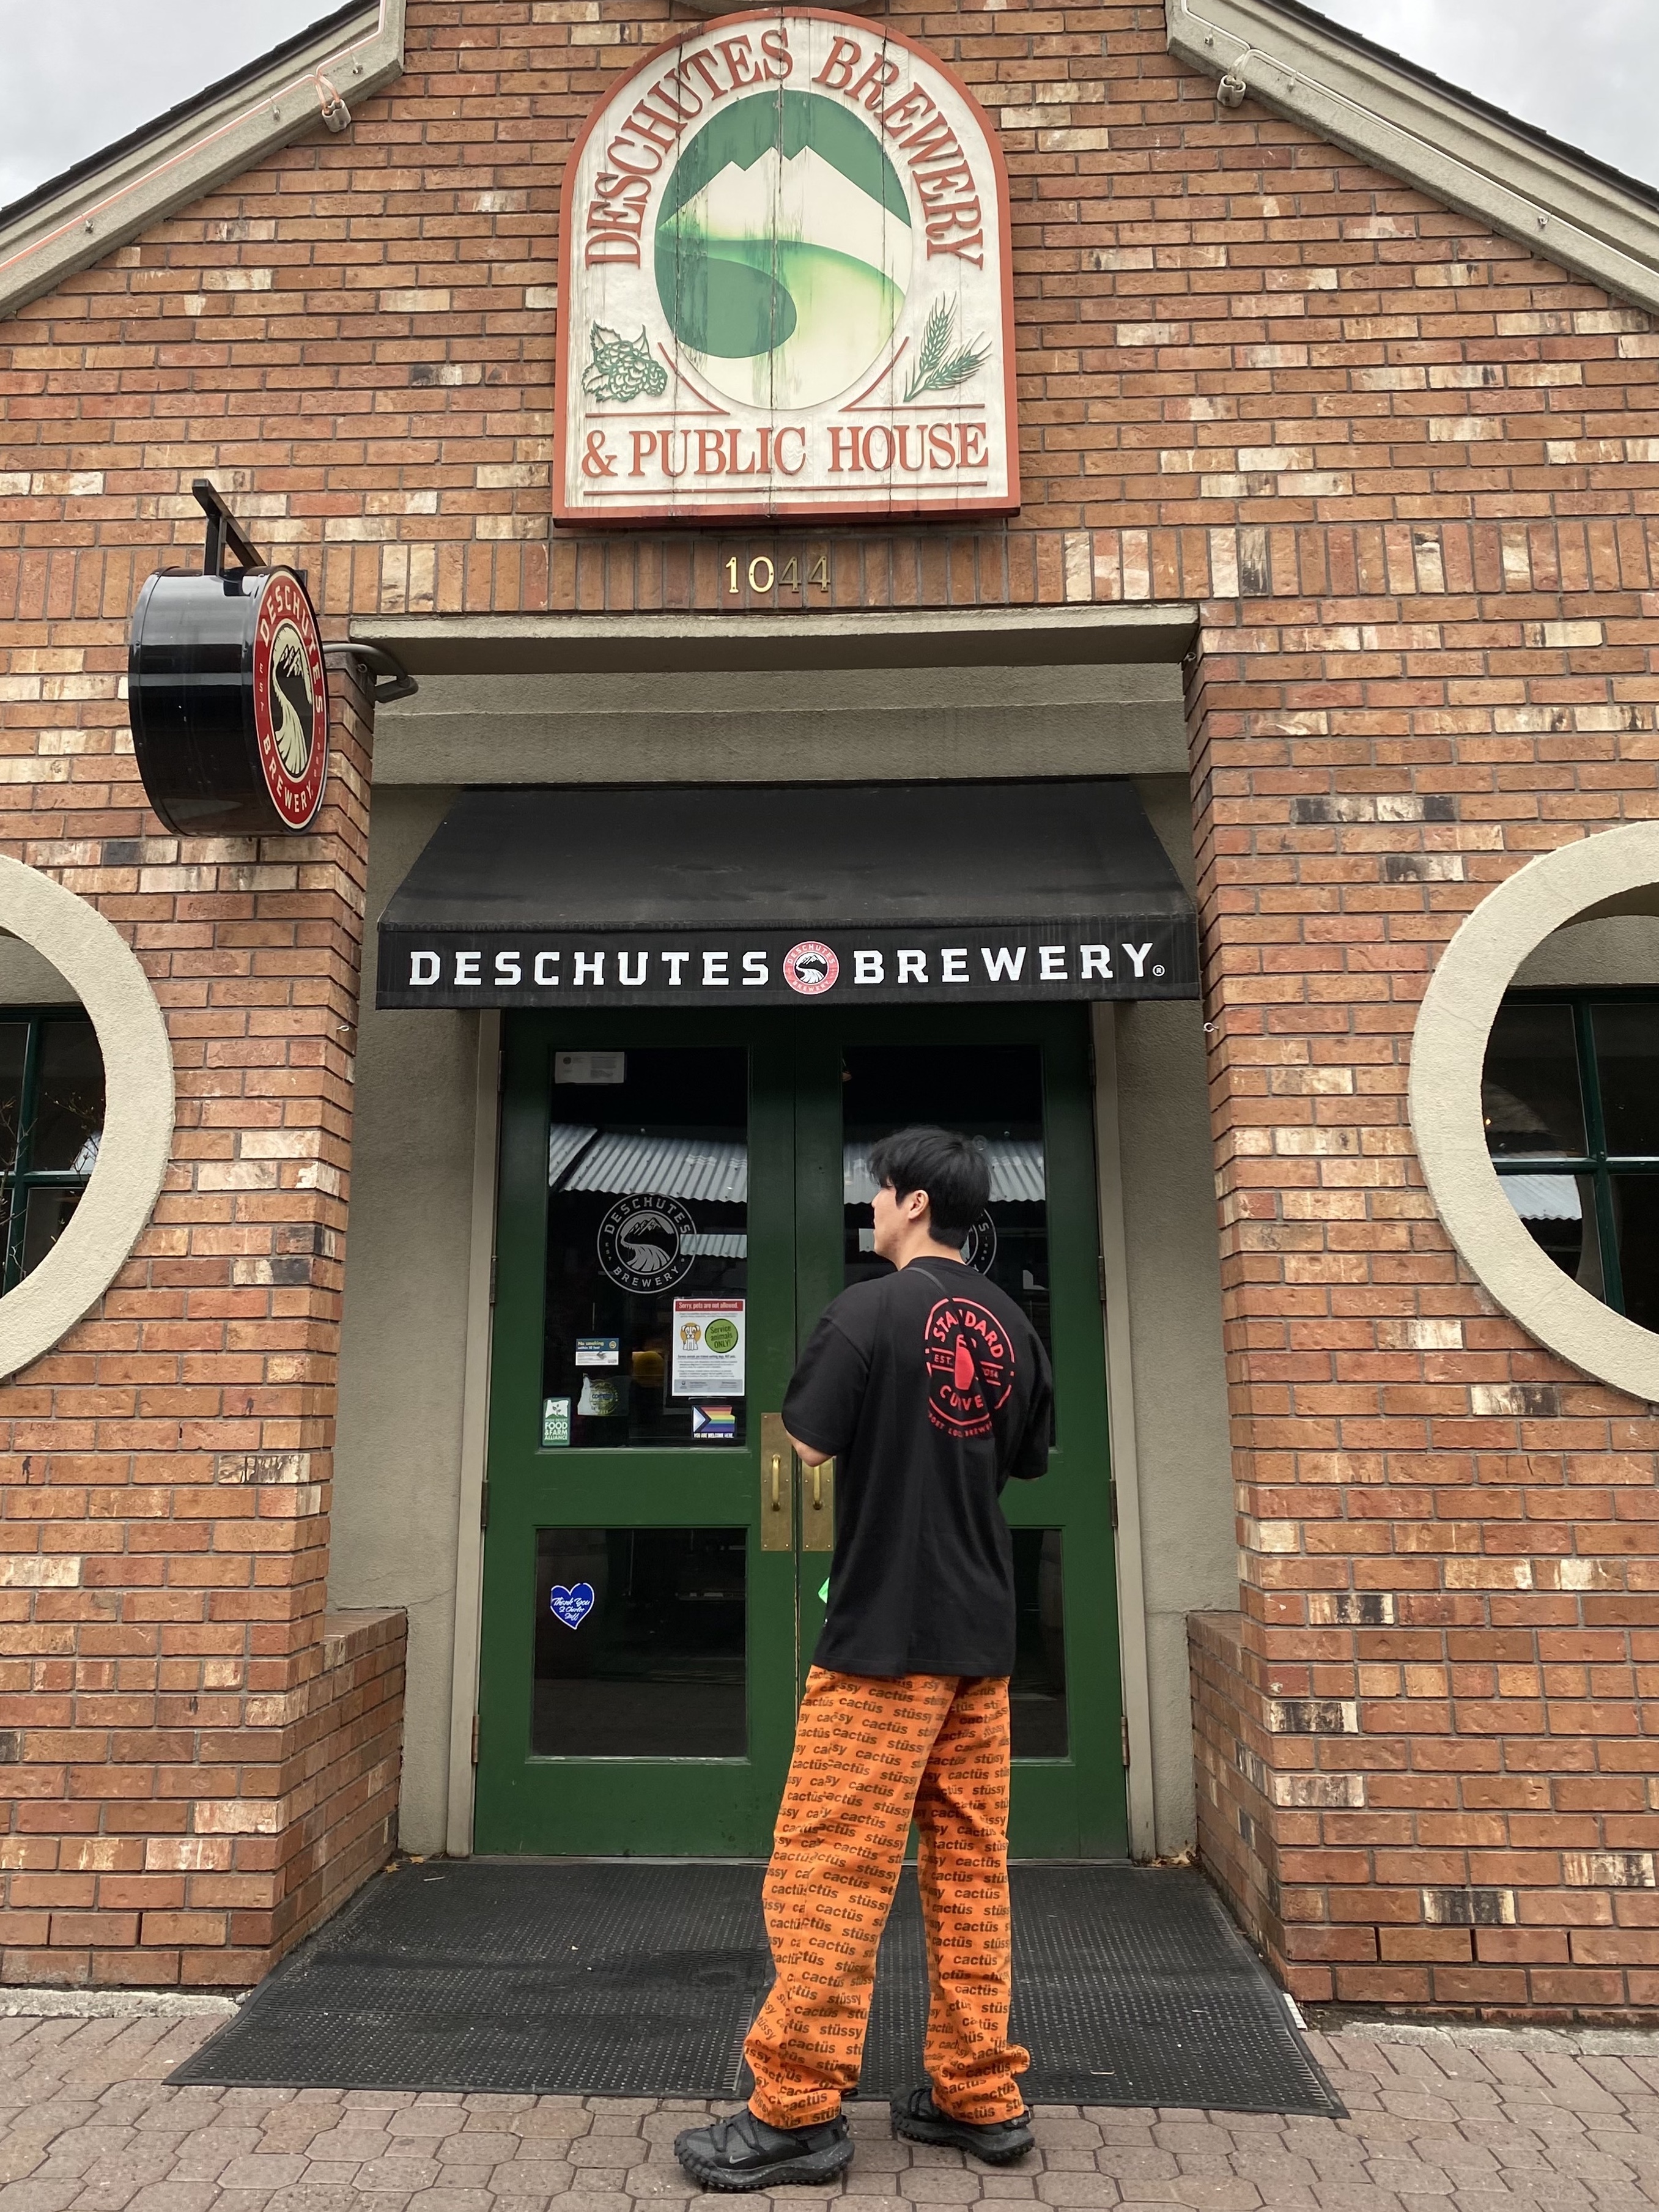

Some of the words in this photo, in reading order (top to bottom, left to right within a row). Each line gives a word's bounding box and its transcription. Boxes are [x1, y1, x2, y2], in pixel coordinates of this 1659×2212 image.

[585, 28, 793, 270] DESCHUTES
[812, 35, 983, 270] BREWERY
[581, 429, 618, 478] &
[628, 426, 806, 476] PUBLIC
[827, 422, 989, 472] HOUSE
[725, 556, 830, 593] 1044
[260, 585, 323, 714] DESCHUTES
[262, 734, 314, 813] BREWERY
[787, 944, 835, 964] DESCHUTES
[409, 951, 769, 985] DESCHUTES
[793, 980, 830, 991] BREWERY
[604, 1197, 691, 1234] DESCHUTES
[613, 1265, 679, 1287] BREWERY
[711, 1333, 733, 1341] animals
[839, 1697, 883, 1713] cactüs
[862, 1718, 908, 1734] cactüs
[833, 1728, 878, 1744] cactüs
[855, 1750, 901, 1766] cactüs
[948, 1769, 989, 1780] cactüs
[849, 1781, 895, 1797] cactüs
[972, 1785, 1006, 1796] stüssy
[840, 1812, 886, 1829] cactüs
[833, 1842, 878, 1860] cactüs
[955, 1857, 1001, 1868] cactüs
[823, 1871, 870, 1889] cactüs
[955, 1888, 1000, 1899] cactüs
[816, 1904, 863, 1922] cactüs
[954, 1921, 999, 1932] cactüs
[808, 1937, 855, 1956] cactüs
[953, 1955, 997, 1966] cactüs
[955, 1985, 999, 1996] cactüs
[794, 2005, 838, 2018] cactüs
[819, 2024, 863, 2040] stüssy
[788, 2038, 835, 2054] cactüs
